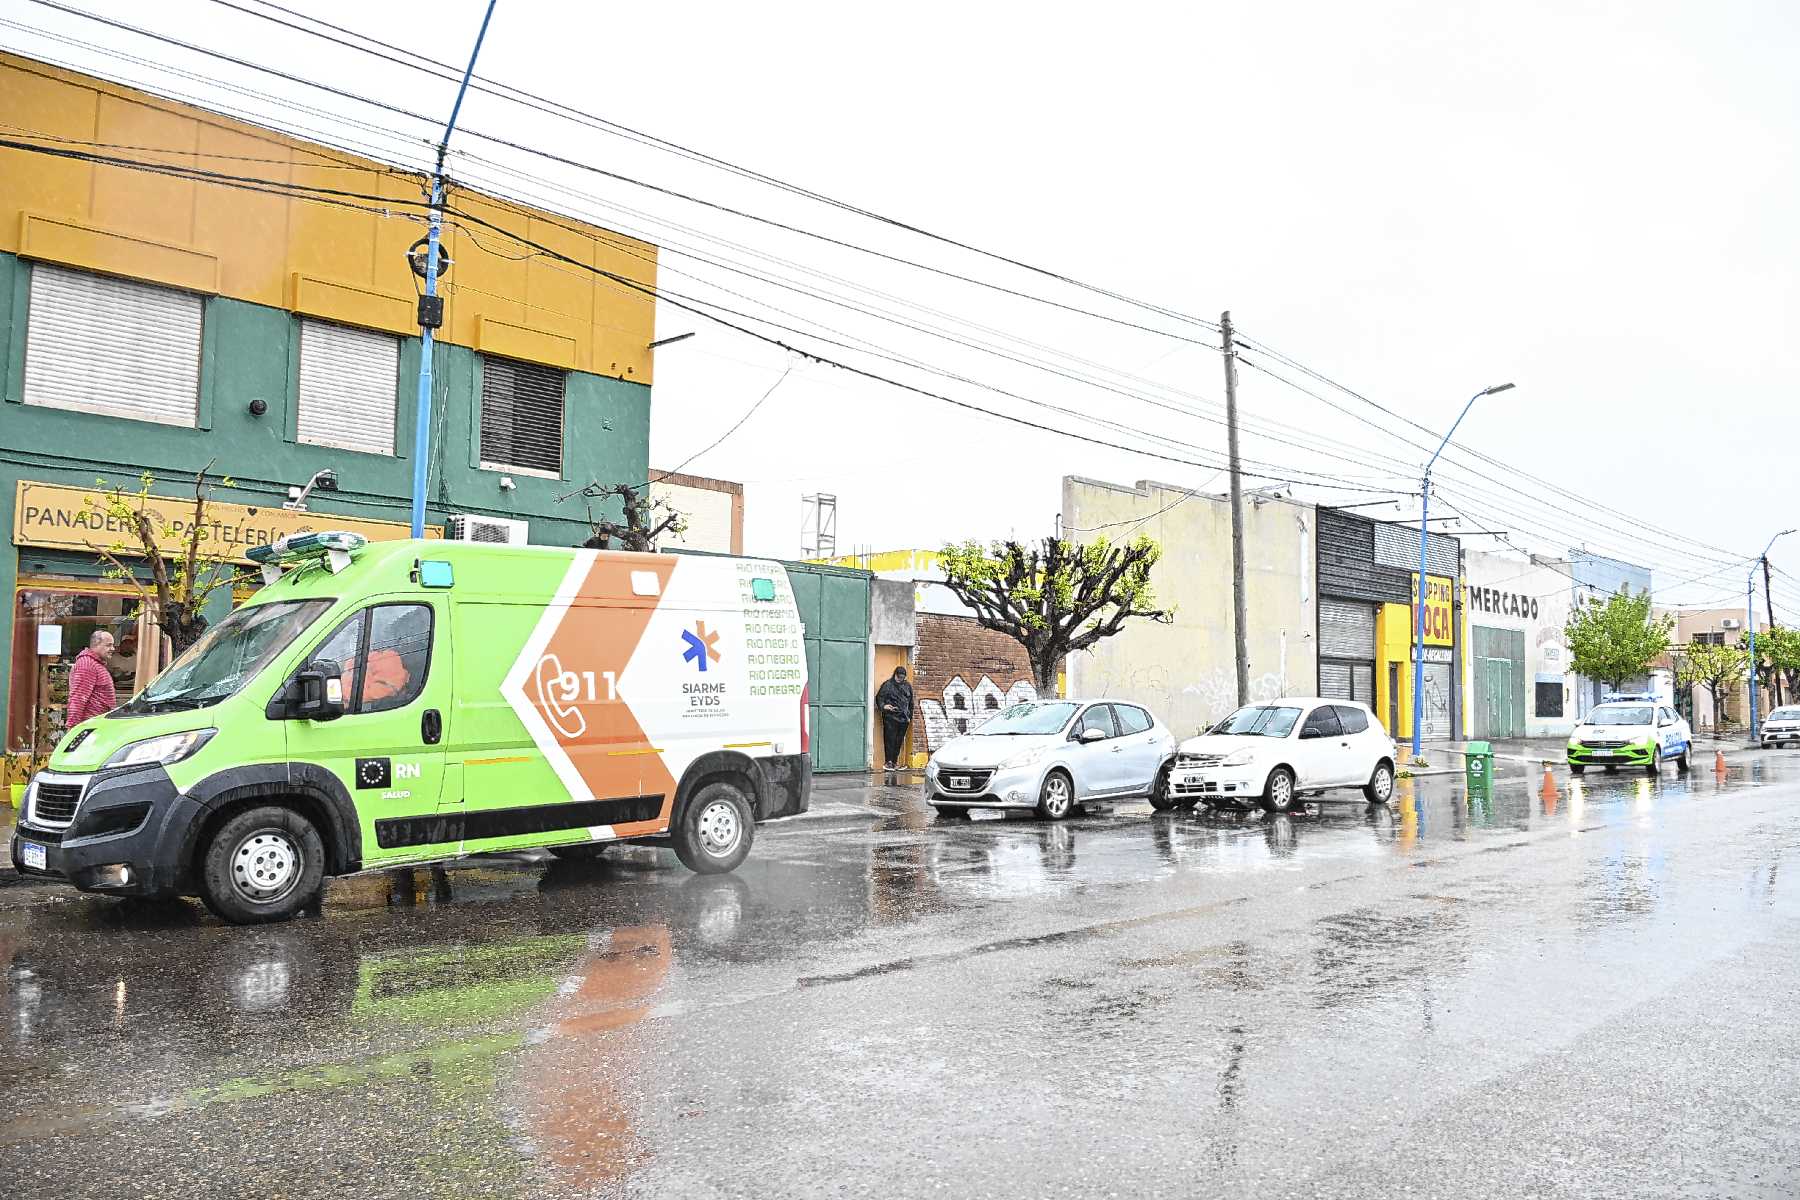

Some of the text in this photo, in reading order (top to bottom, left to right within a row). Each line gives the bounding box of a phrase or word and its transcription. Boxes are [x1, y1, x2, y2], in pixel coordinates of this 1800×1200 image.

[1413, 578, 1450, 602] SOPPING
[1470, 585, 1538, 620] MERCADO
[745, 624, 761, 633] RIO
[746, 639, 763, 648] RIO
[748, 654, 799, 664] RIO NEGRO
[749, 669, 801, 680] RIO NEGRO
[560, 671, 616, 701] 911
[682, 683, 726, 693] SIARME
[750, 684, 802, 695] RIO NEGRO
[690, 695, 721, 706] EYDS
[396, 763, 421, 779] RN
